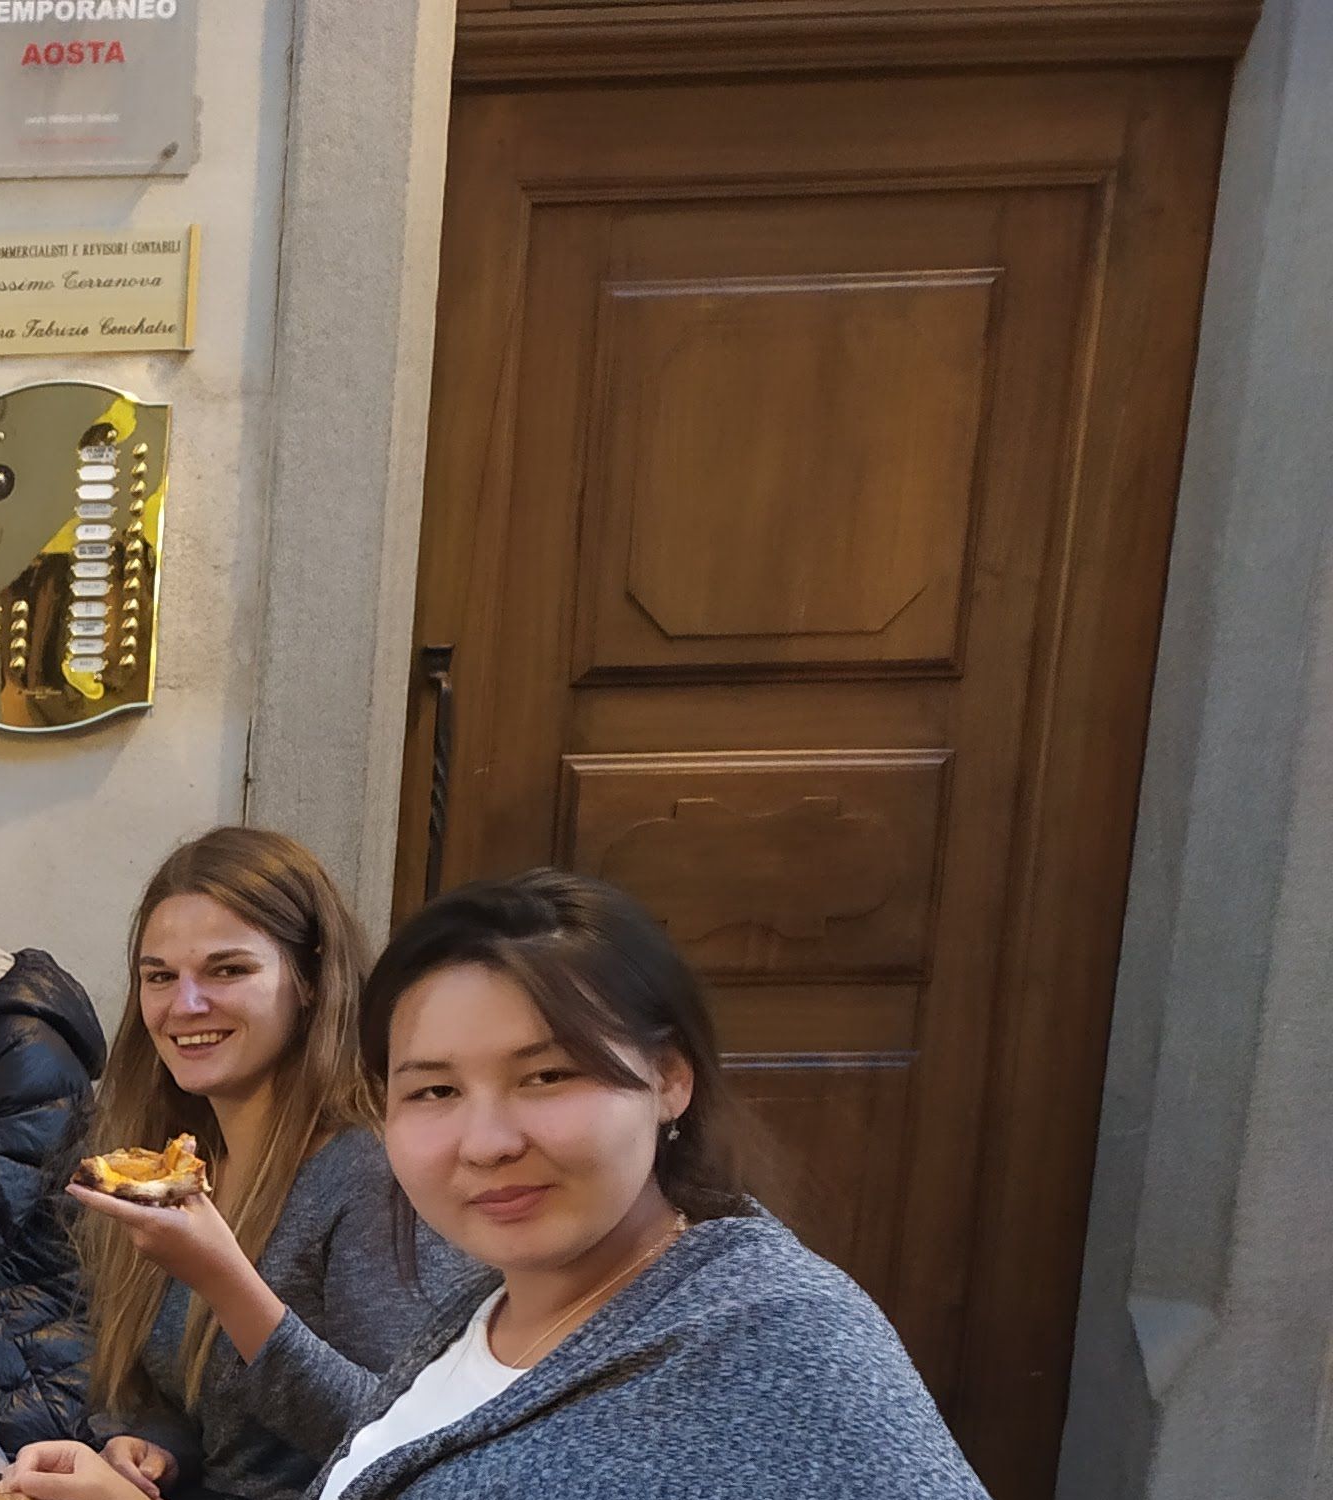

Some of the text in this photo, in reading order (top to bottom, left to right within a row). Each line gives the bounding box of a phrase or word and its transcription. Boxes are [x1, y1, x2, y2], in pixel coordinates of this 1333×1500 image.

[20, 40, 126, 67] AOSTA
[72, 244, 79, 257] E
[82, 242, 129, 257] REVISORI
[131, 240, 182, 255] CONTABILI
[21, 318, 90, 339] Fabrizio
